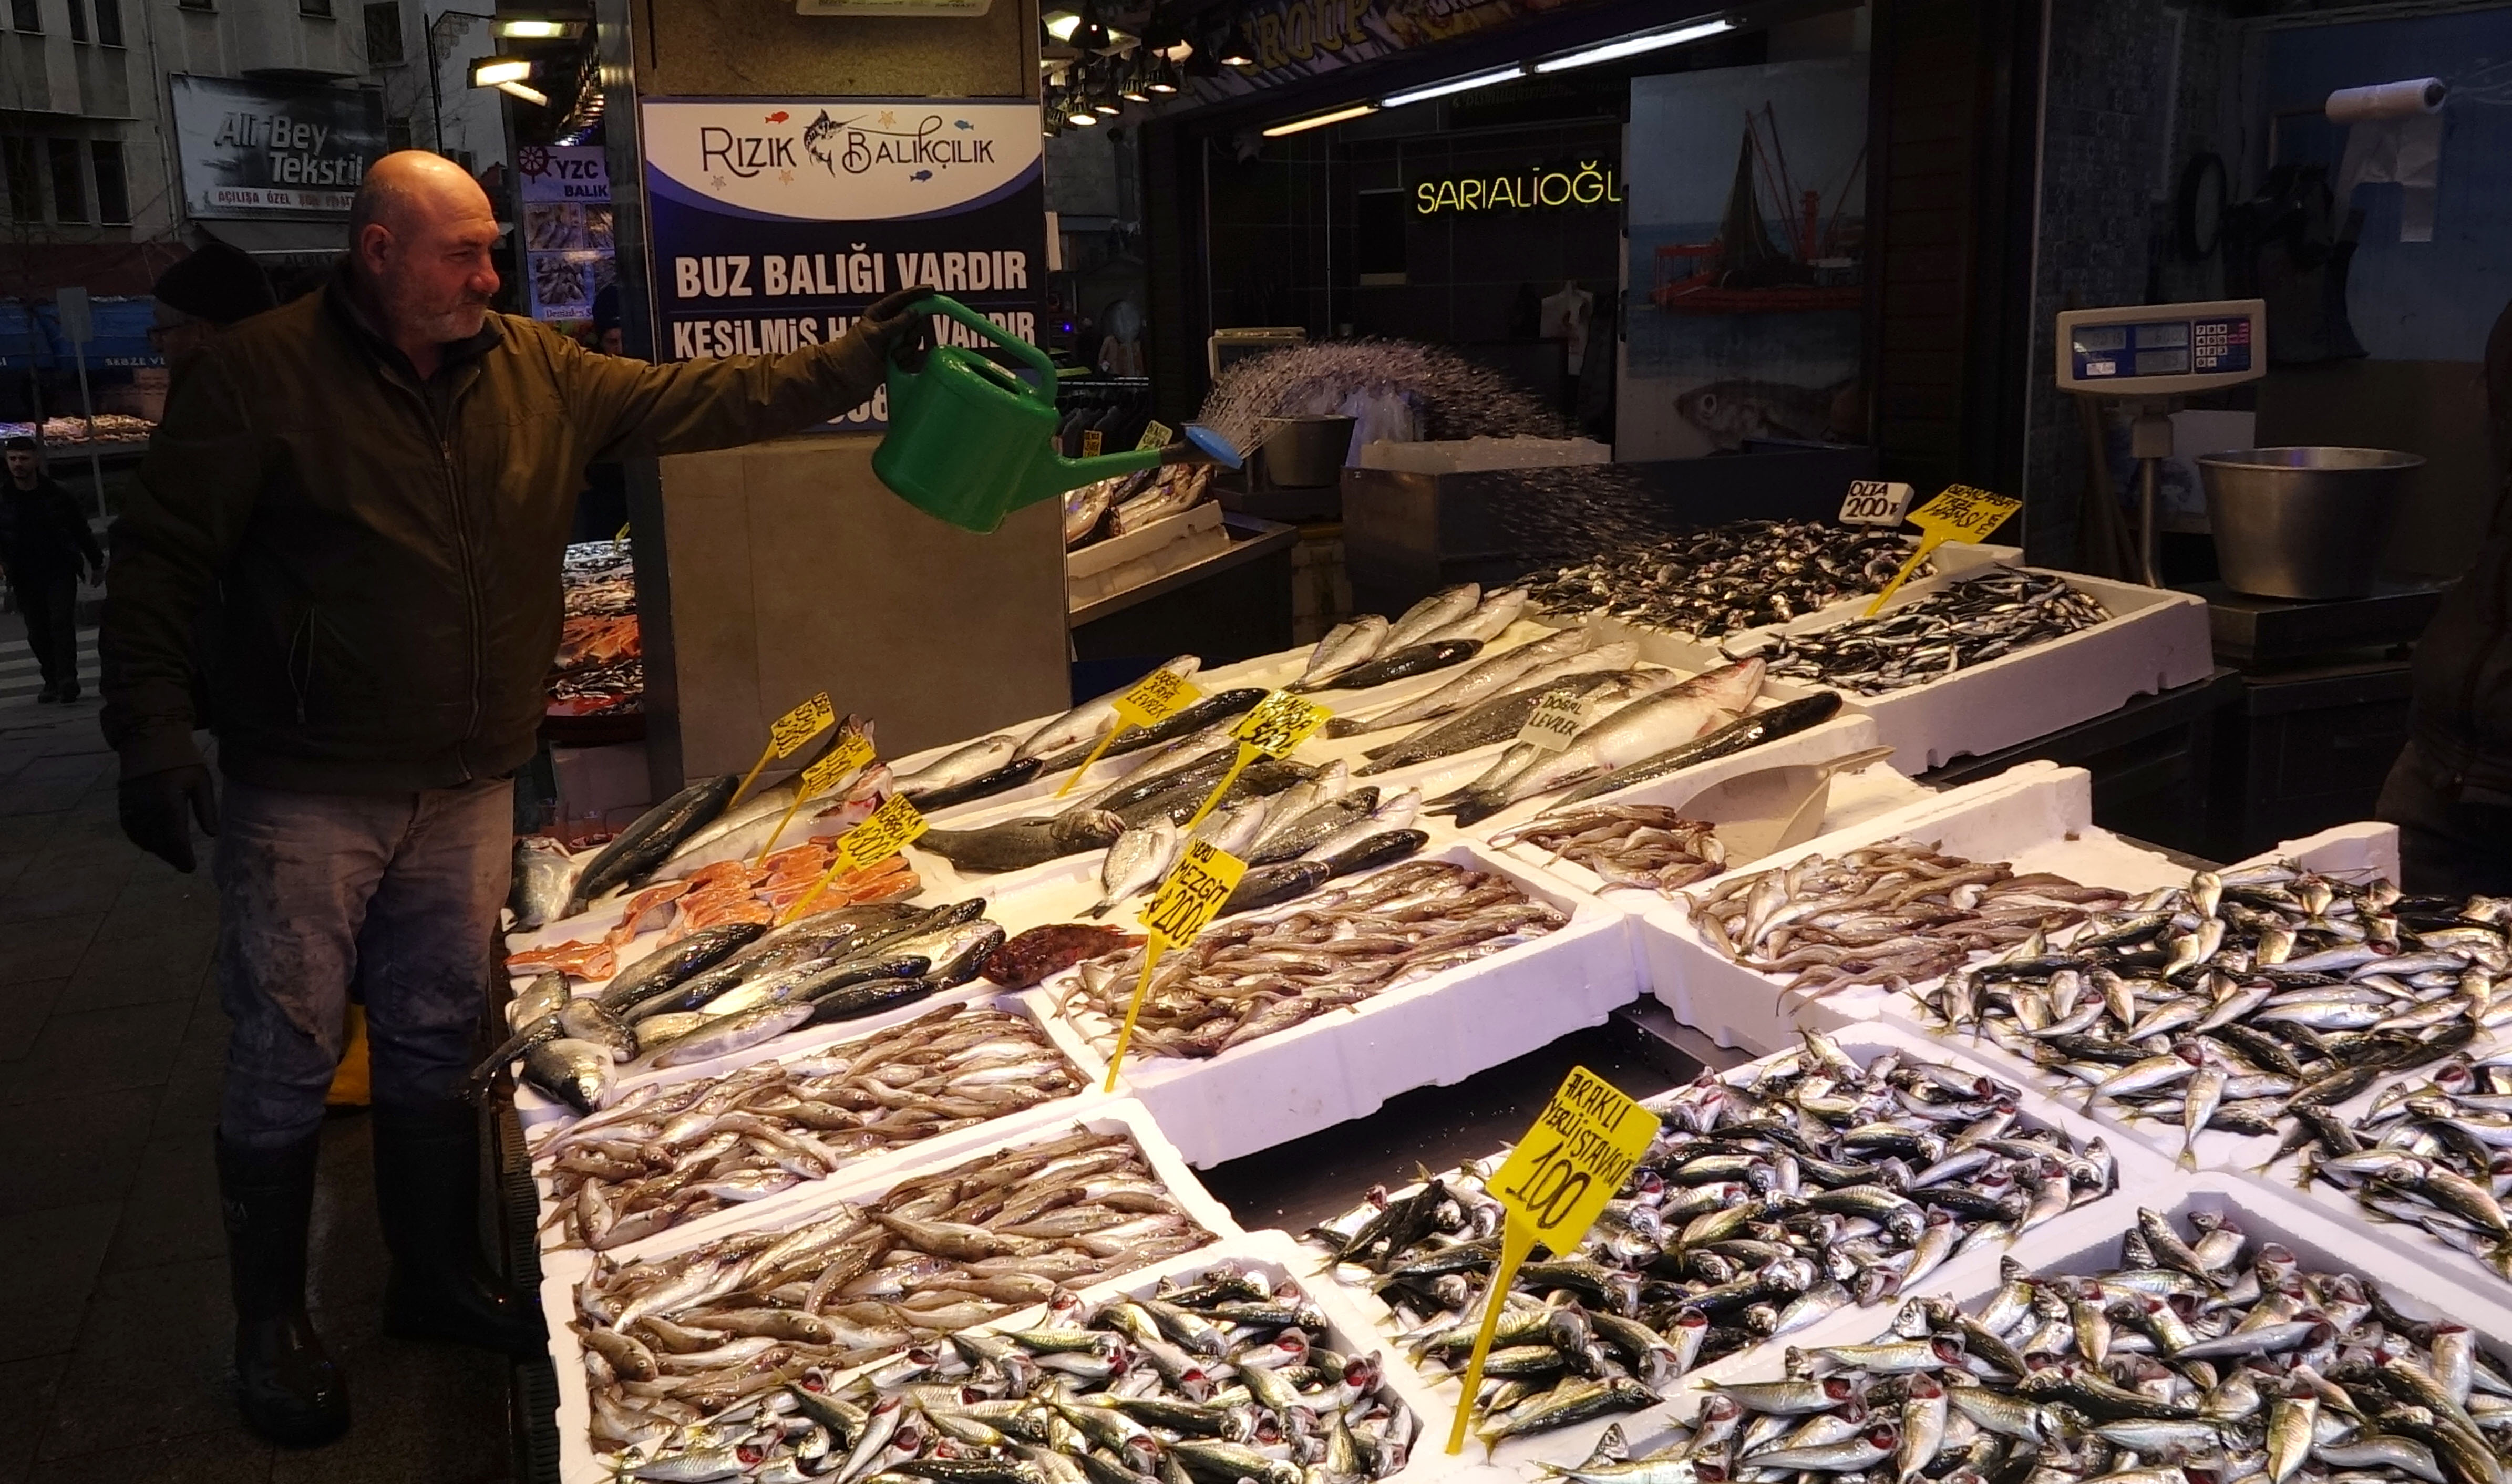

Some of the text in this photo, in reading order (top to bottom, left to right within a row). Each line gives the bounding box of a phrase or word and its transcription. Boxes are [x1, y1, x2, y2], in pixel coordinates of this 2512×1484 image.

[214, 112, 328, 157] Ali Bey
[700, 115, 995, 177] RIZIK BALIKÇILIK
[269, 151, 363, 186] Tekstil
[555, 160, 598, 179] YZC
[267, 190, 291, 204] ÖZEL
[675, 241, 1028, 300] BUZ BALIĞI VARDIR
[1850, 482, 1889, 497] OLTA
[1528, 712, 1580, 737] LEVREK
[1170, 858, 1230, 904] MEZGİT
[1564, 1073, 1632, 1134] ARAKLI
[1505, 1141, 1592, 1230] 100
